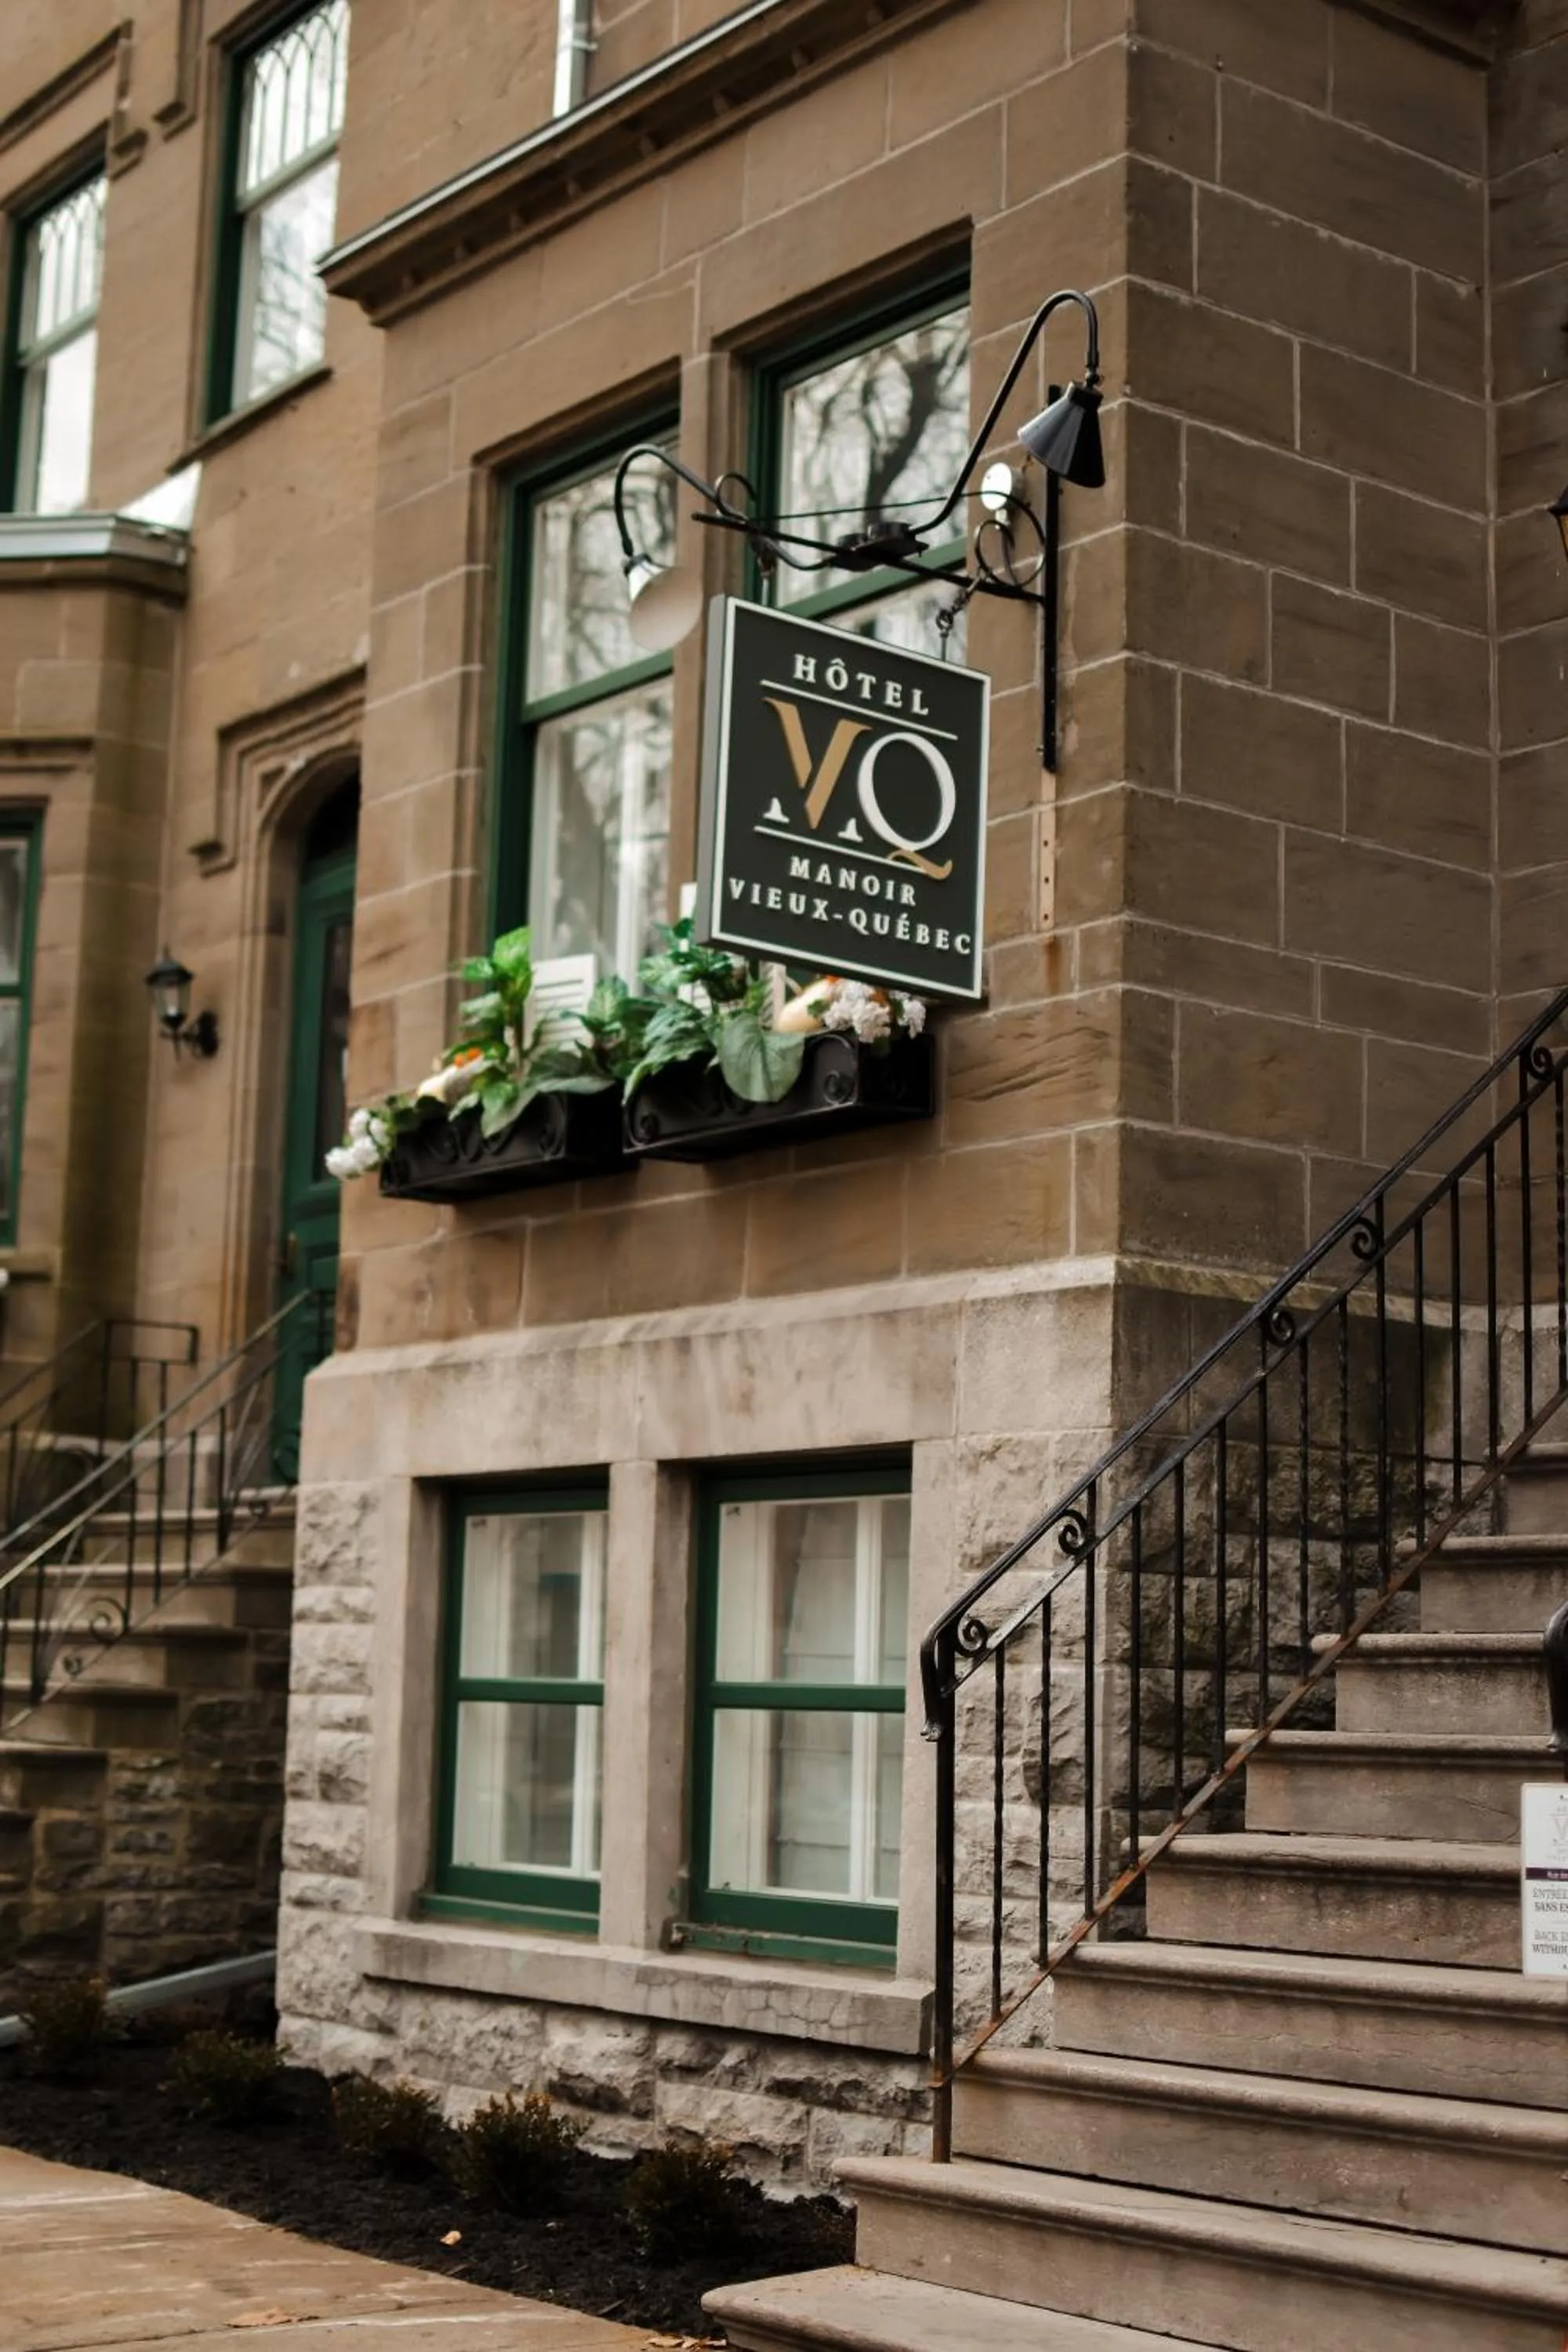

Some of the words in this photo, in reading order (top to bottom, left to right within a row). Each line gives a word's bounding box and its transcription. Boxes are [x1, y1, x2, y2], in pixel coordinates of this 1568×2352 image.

[793, 654, 929, 716] HÔTEL
[763, 696, 956, 880] VQ
[728, 877, 972, 955] VIEUX-QUÉBEC
[789, 855, 917, 907] MANOIR
